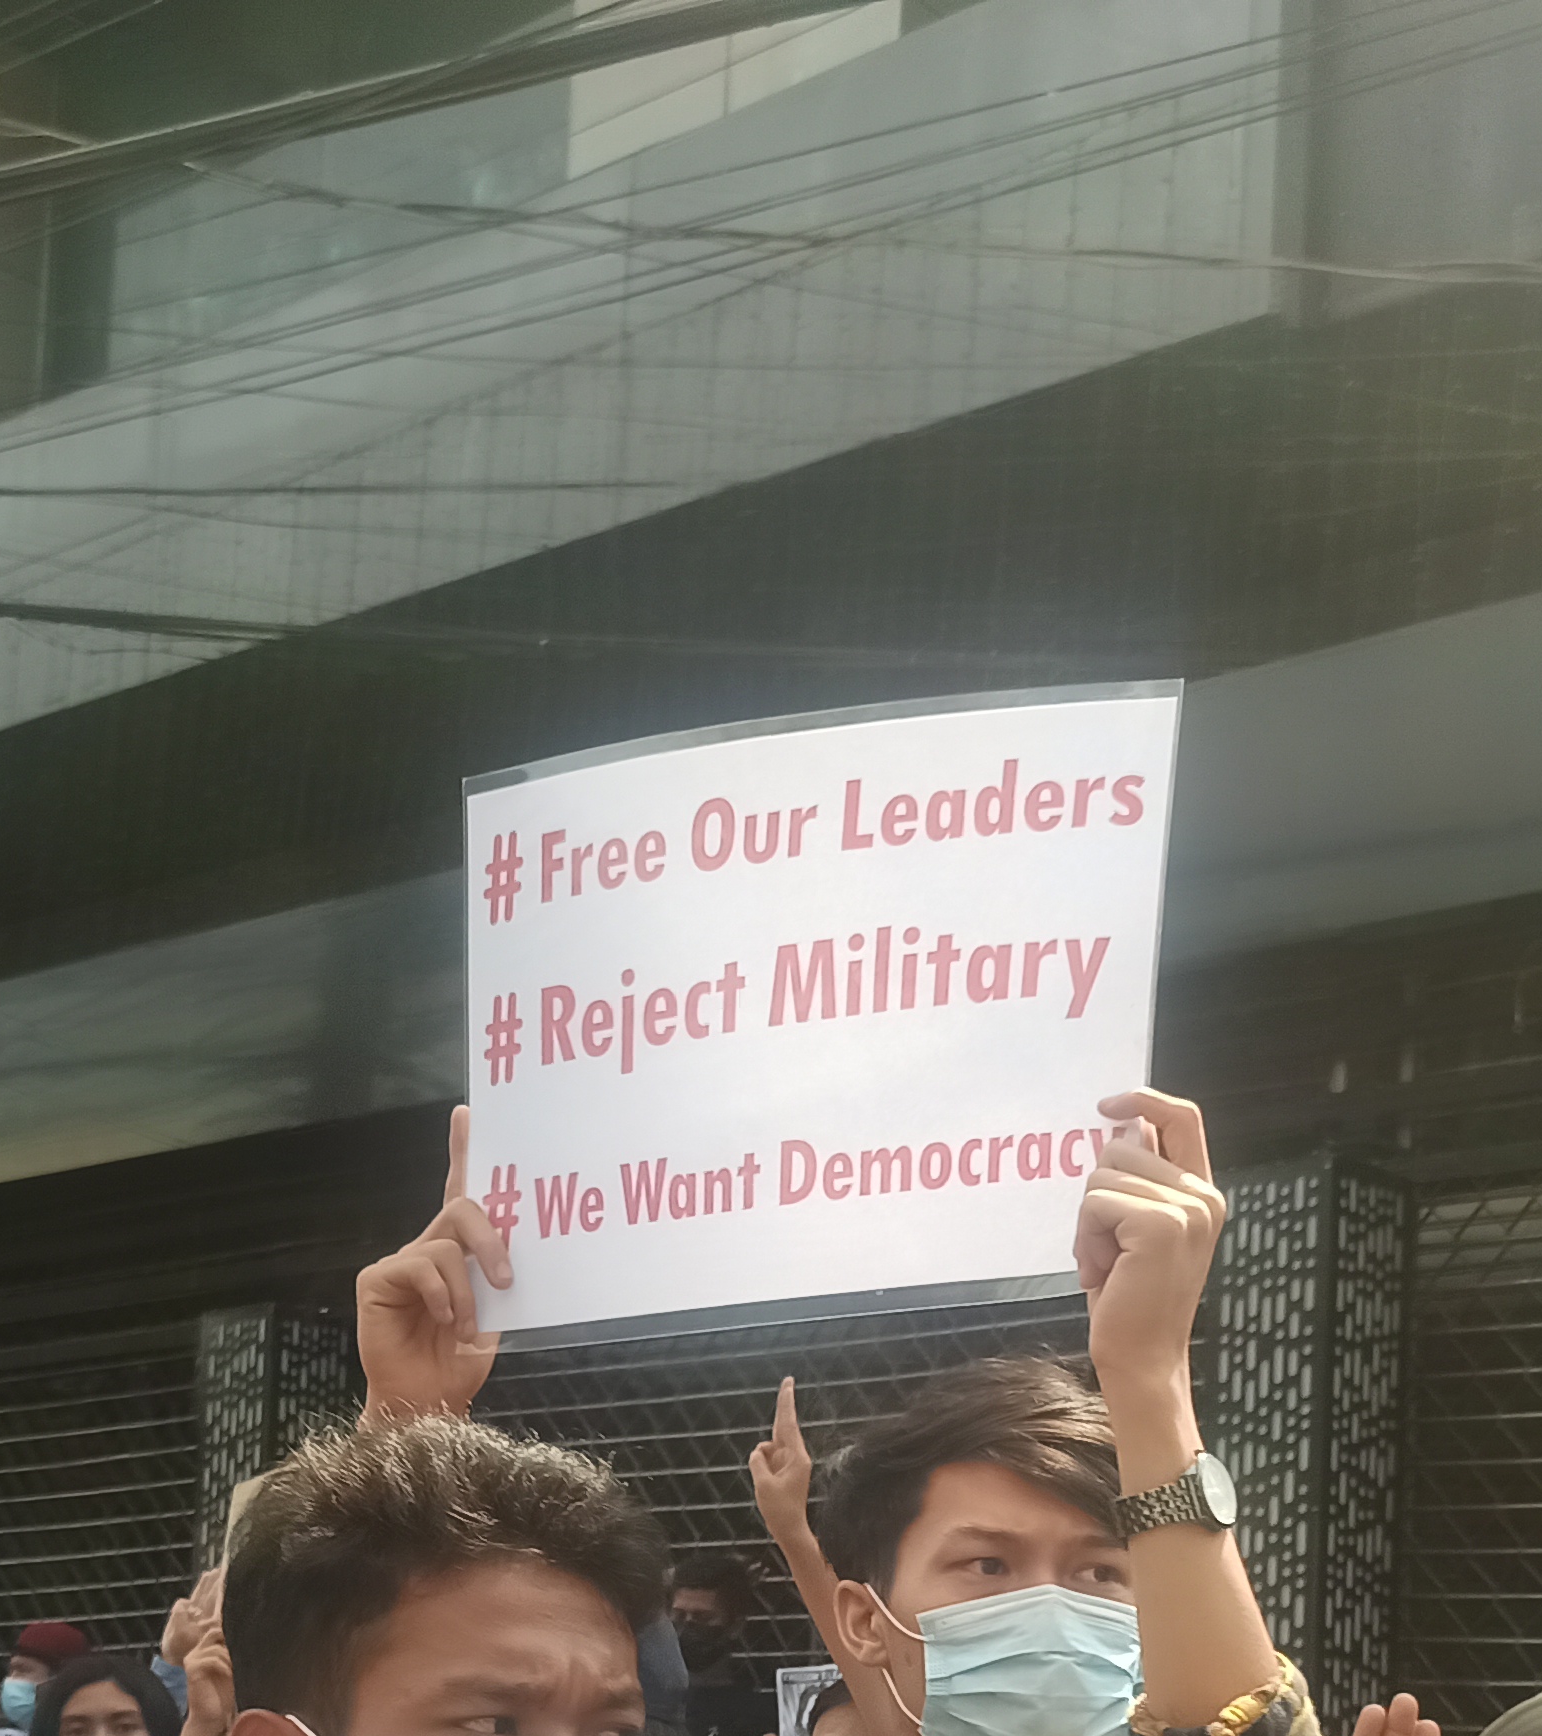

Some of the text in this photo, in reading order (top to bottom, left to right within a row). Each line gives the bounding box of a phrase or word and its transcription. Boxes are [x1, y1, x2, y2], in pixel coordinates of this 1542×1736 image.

[541, 830, 666, 902] Free
[691, 797, 818, 872] Our
[841, 759, 1145, 850] Leaders
[540, 962, 746, 1074] Reject
[769, 926, 1110, 1026] Military
[534, 1171, 605, 1239] We
[621, 1153, 761, 1226] Want
